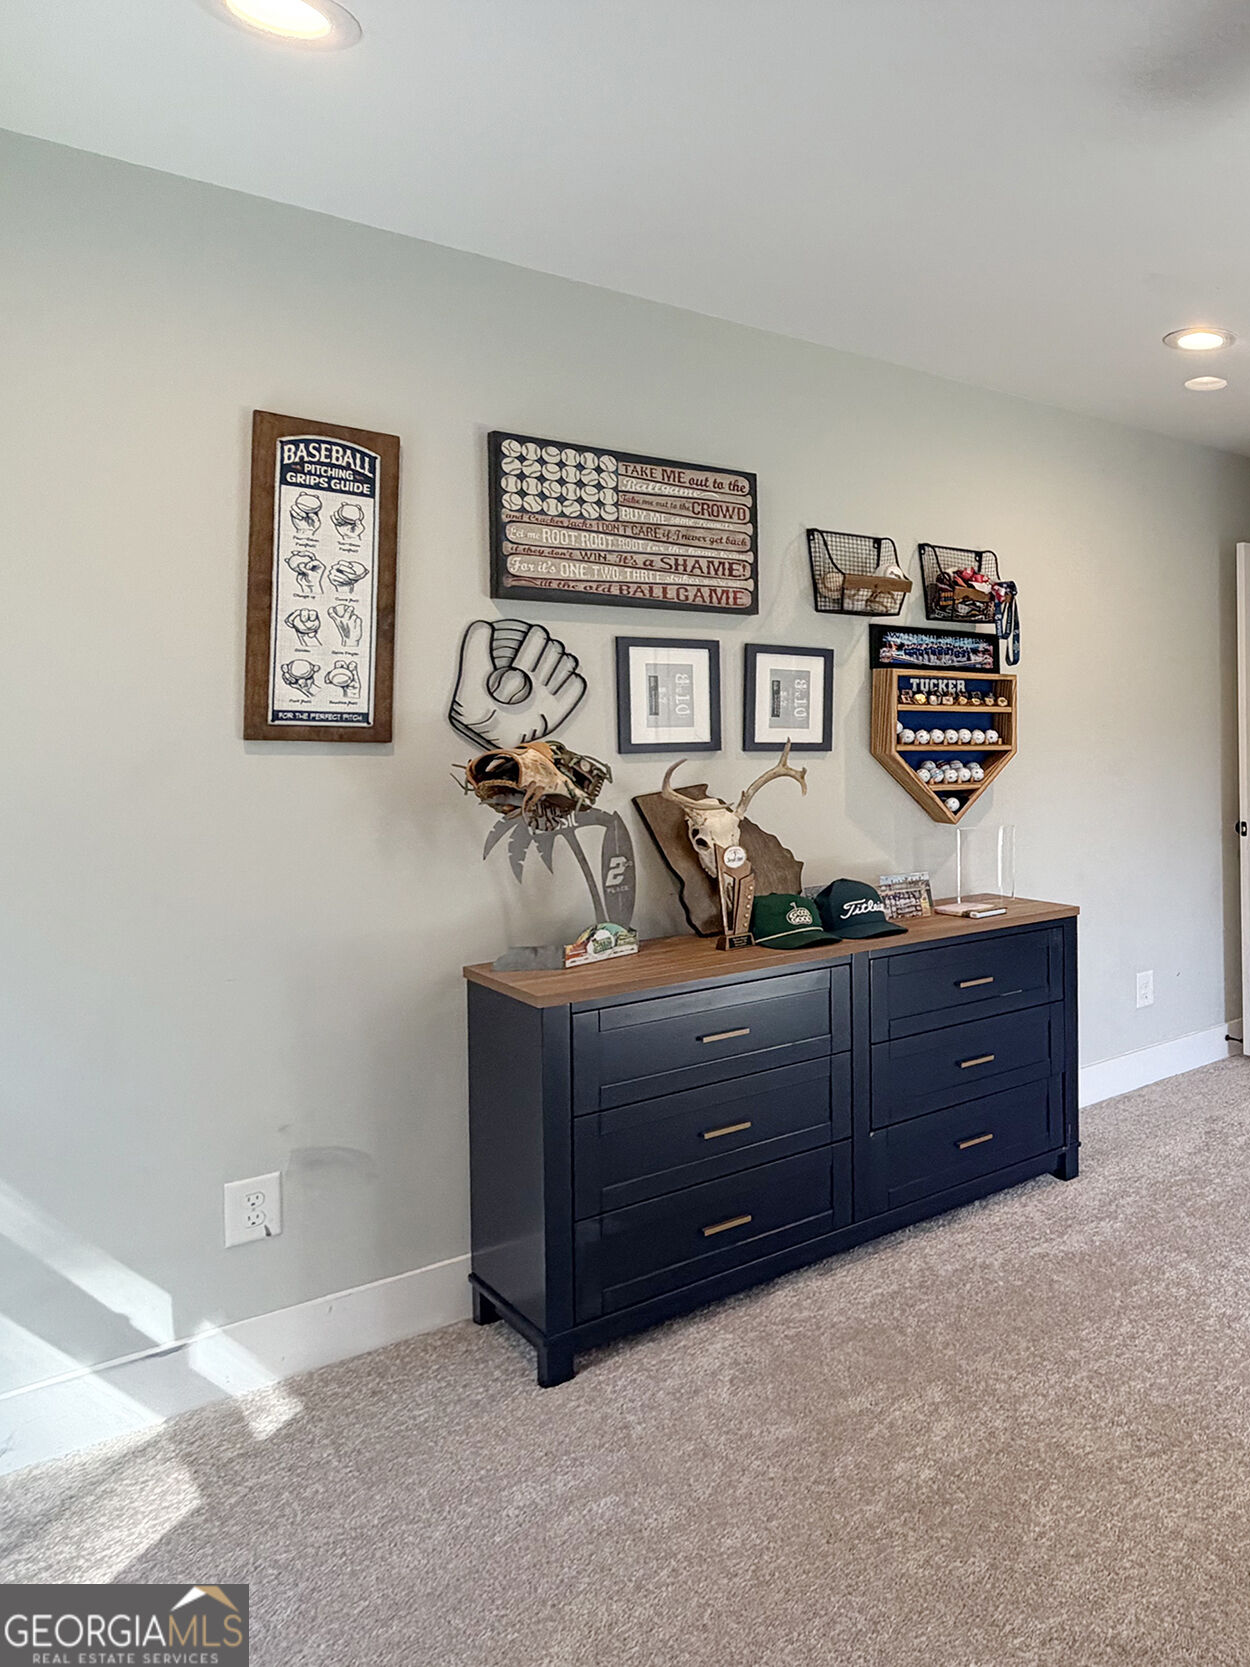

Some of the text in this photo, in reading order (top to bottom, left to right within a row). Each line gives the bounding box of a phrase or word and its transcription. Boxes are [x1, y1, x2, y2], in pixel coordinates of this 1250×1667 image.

[283, 443, 374, 478] BASEBALL
[304, 464, 354, 480] PITCHING
[622, 464, 746, 493] TAKE ME out to the
[286, 472, 371, 495] GRIPS GUIDE
[622, 506, 647, 521] BUY
[650, 512, 668, 524] ME
[655, 500, 668, 508] out
[691, 501, 746, 521] CROWD
[505, 512, 524, 520] and
[631, 524, 661, 539] CARE
[709, 535, 724, 545] get
[510, 556, 535, 573] For
[538, 561, 557, 573] it's
[660, 556, 747, 577] SHAME!
[557, 581, 578, 590] the
[583, 583, 613, 594] old
[619, 584, 745, 606] BALLGAME
[910, 678, 966, 692] TUCKER
